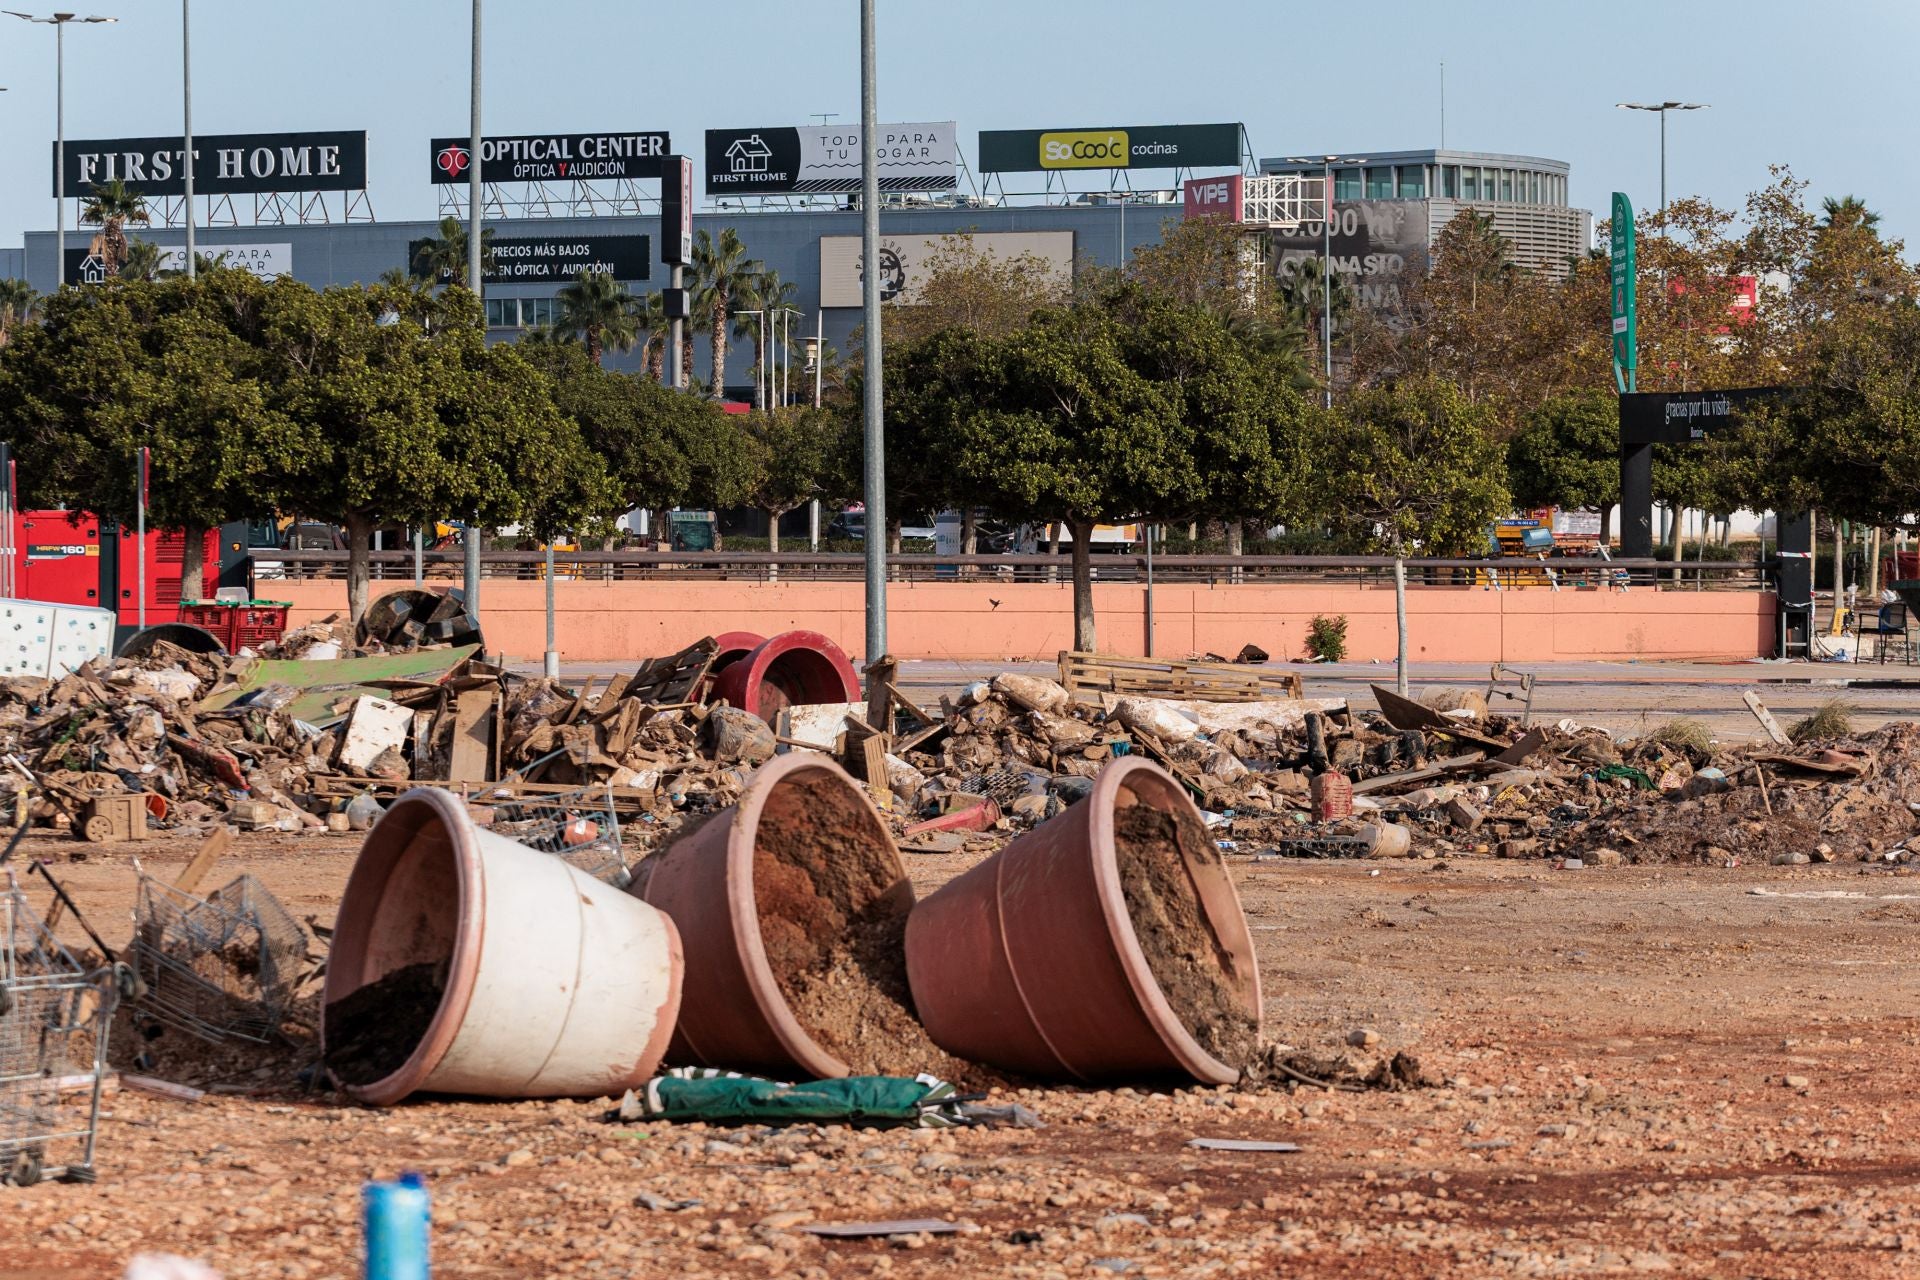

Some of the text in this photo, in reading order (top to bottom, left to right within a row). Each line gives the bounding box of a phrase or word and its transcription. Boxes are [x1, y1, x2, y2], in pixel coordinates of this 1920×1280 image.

[820, 133, 938, 147] TOD PARA
[1131, 140, 1178, 155] cocinas
[480, 135, 664, 162] OPTICAL CENTER
[826, 147, 930, 160] TU OGAR
[77, 145, 341, 183] FIRST HOME
[513, 157, 626, 178] ÓPTICA Y AUDICIÓN
[712, 172, 788, 183] FIRST HOME
[1191, 182, 1229, 206] VIPS
[226, 249, 272, 260] PARA
[491, 245, 532, 258] PRECIOS
[534, 242, 556, 256] MÁS
[558, 244, 590, 256] BAJOS
[514, 261, 550, 276] ÓPTICA
[552, 264, 559, 275] Y
[1664, 393, 1731, 425] gracias por tu visita
[60, 545, 85, 554] 160
